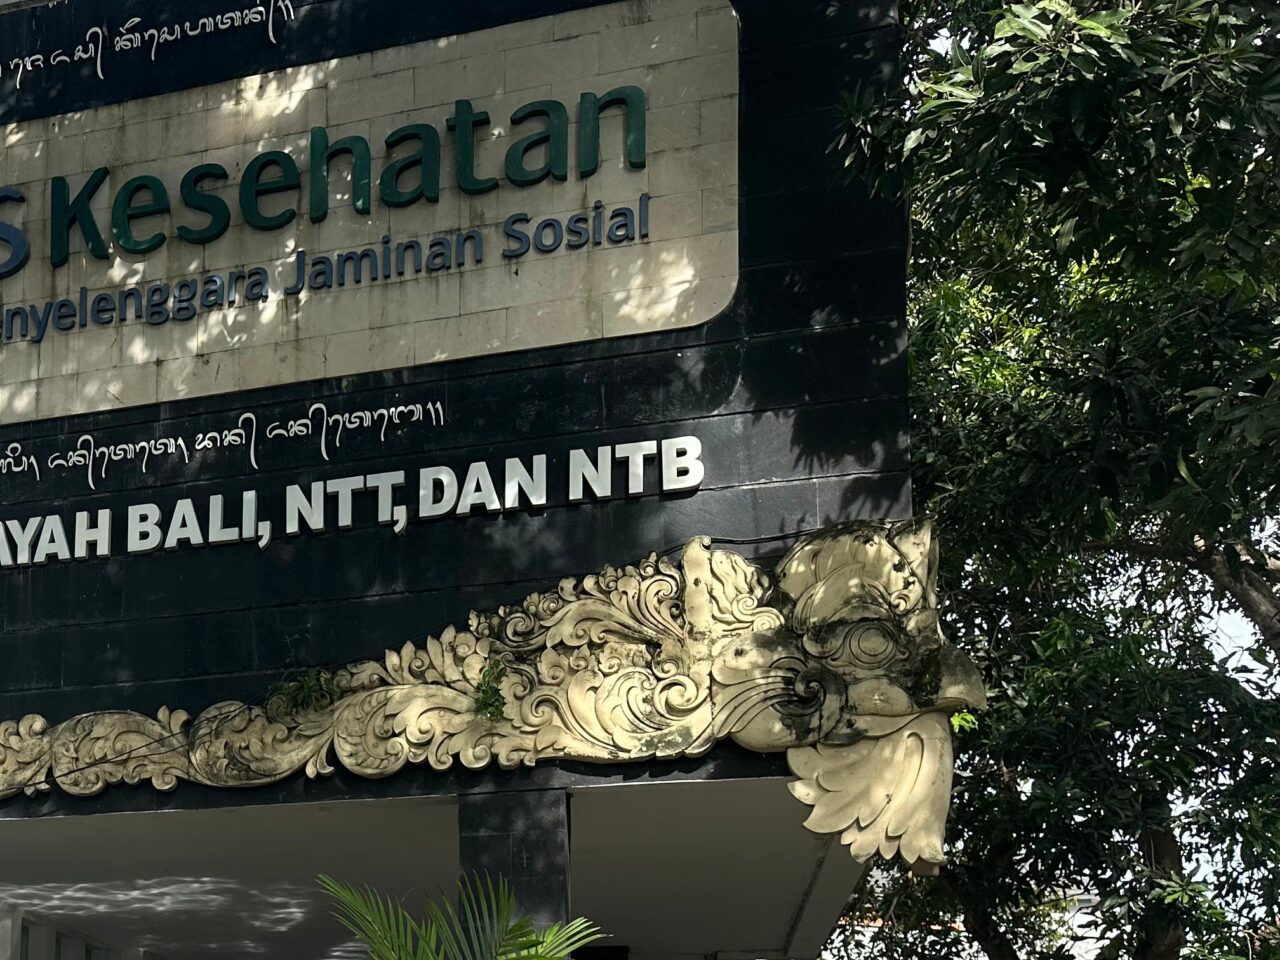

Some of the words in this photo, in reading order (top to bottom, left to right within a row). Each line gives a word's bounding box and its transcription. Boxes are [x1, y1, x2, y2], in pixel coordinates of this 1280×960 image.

[50, 85, 647, 268] Kesehatan
[285, 226, 483, 295] Jaminan
[502, 192, 650, 258] Sosial
[127, 490, 272, 552] BALI,
[286, 470, 407, 534] NTT,
[419, 454, 548, 517] DAN
[568, 435, 706, 501] NTB
